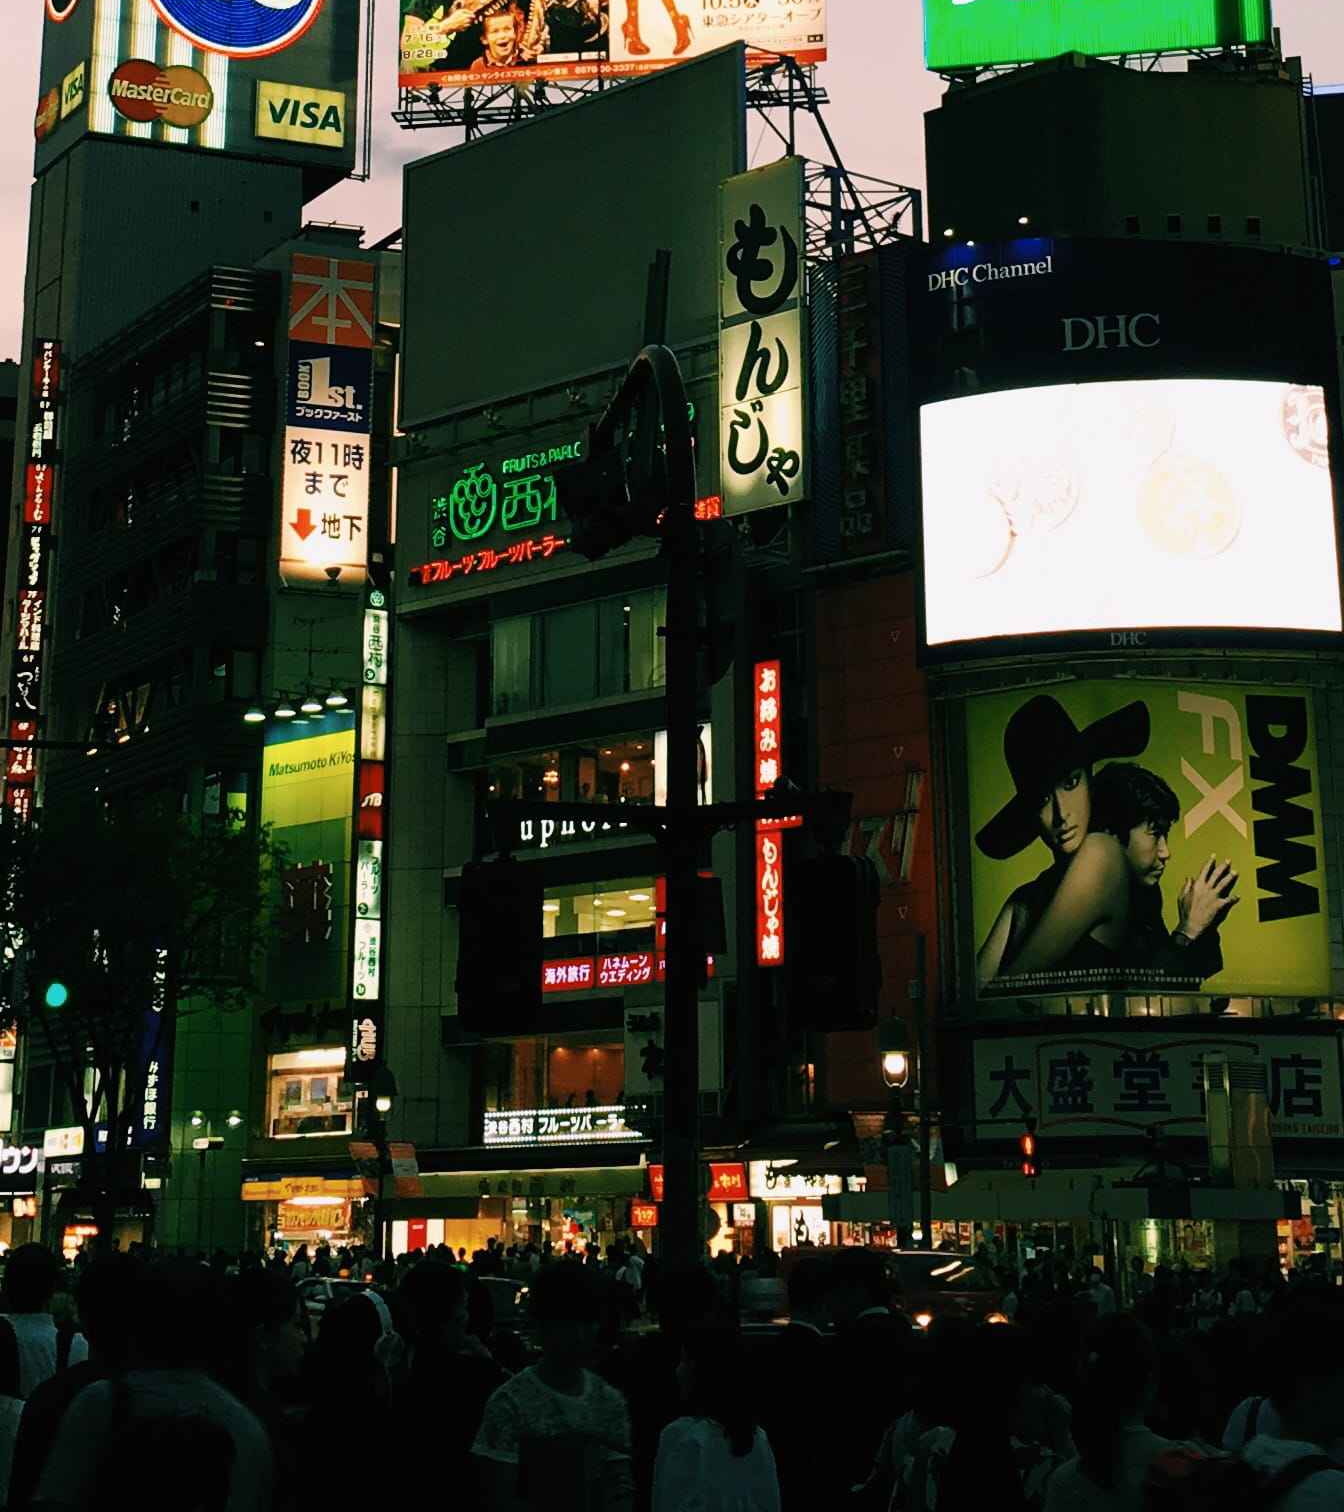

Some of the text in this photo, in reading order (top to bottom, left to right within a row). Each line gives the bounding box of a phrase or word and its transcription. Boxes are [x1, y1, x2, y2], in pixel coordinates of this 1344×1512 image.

[110, 78, 212, 110] MasterCard
[268, 97, 343, 134] VISA
[927, 255, 1054, 292] DHC Channel
[1060, 312, 1162, 352] DHC
[726, 204, 800, 497] もんじゃ
[295, 405, 363, 424] ブックファースト
[290, 438, 365, 472] 夜11時
[304, 471, 349, 499] まで
[321, 512, 362, 542] 地下
[432, 498, 447, 547] 渋谷
[1109, 632, 1146, 647] DHC
[268, 756, 328, 778] Matsumoto
[1176, 690, 1248, 840] FX
[361, 791, 383, 808] JTB
[1245, 693, 1321, 923] DMM
[544, 964, 591, 986] 海外旅行
[599, 966, 651, 985] ウエディング
[602, 954, 648, 970] ハネムーン
[143, 1059, 160, 1131] みずほ銀行
